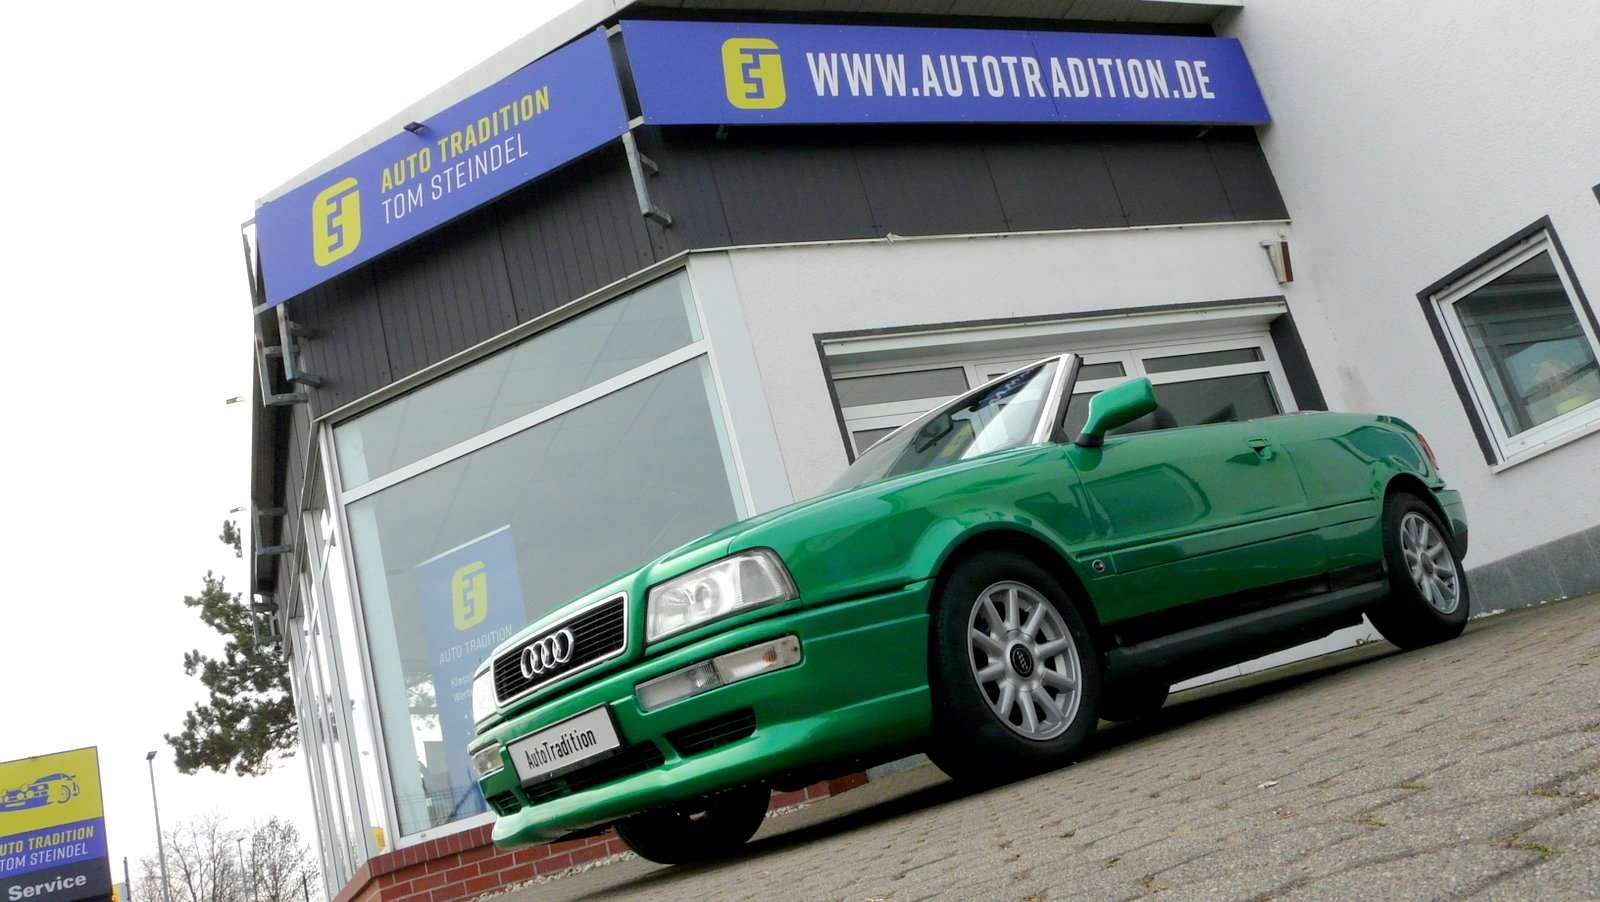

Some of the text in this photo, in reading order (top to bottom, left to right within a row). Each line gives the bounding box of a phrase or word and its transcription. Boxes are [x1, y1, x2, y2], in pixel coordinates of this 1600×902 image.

[806, 52, 1216, 100] WWW.AUTOTRADITION.DE
[380, 86, 551, 193] AUTO TRADITION
[382, 133, 528, 225] TOM STEINDEL
[440, 624, 512, 664] AUTO TRADITION
[525, 729, 597, 769] AutoTradition
[0, 825, 95, 857] UTO TRADITION
[0, 842, 89, 873] TOM STEINDEL
[8, 875, 87, 902] Service
